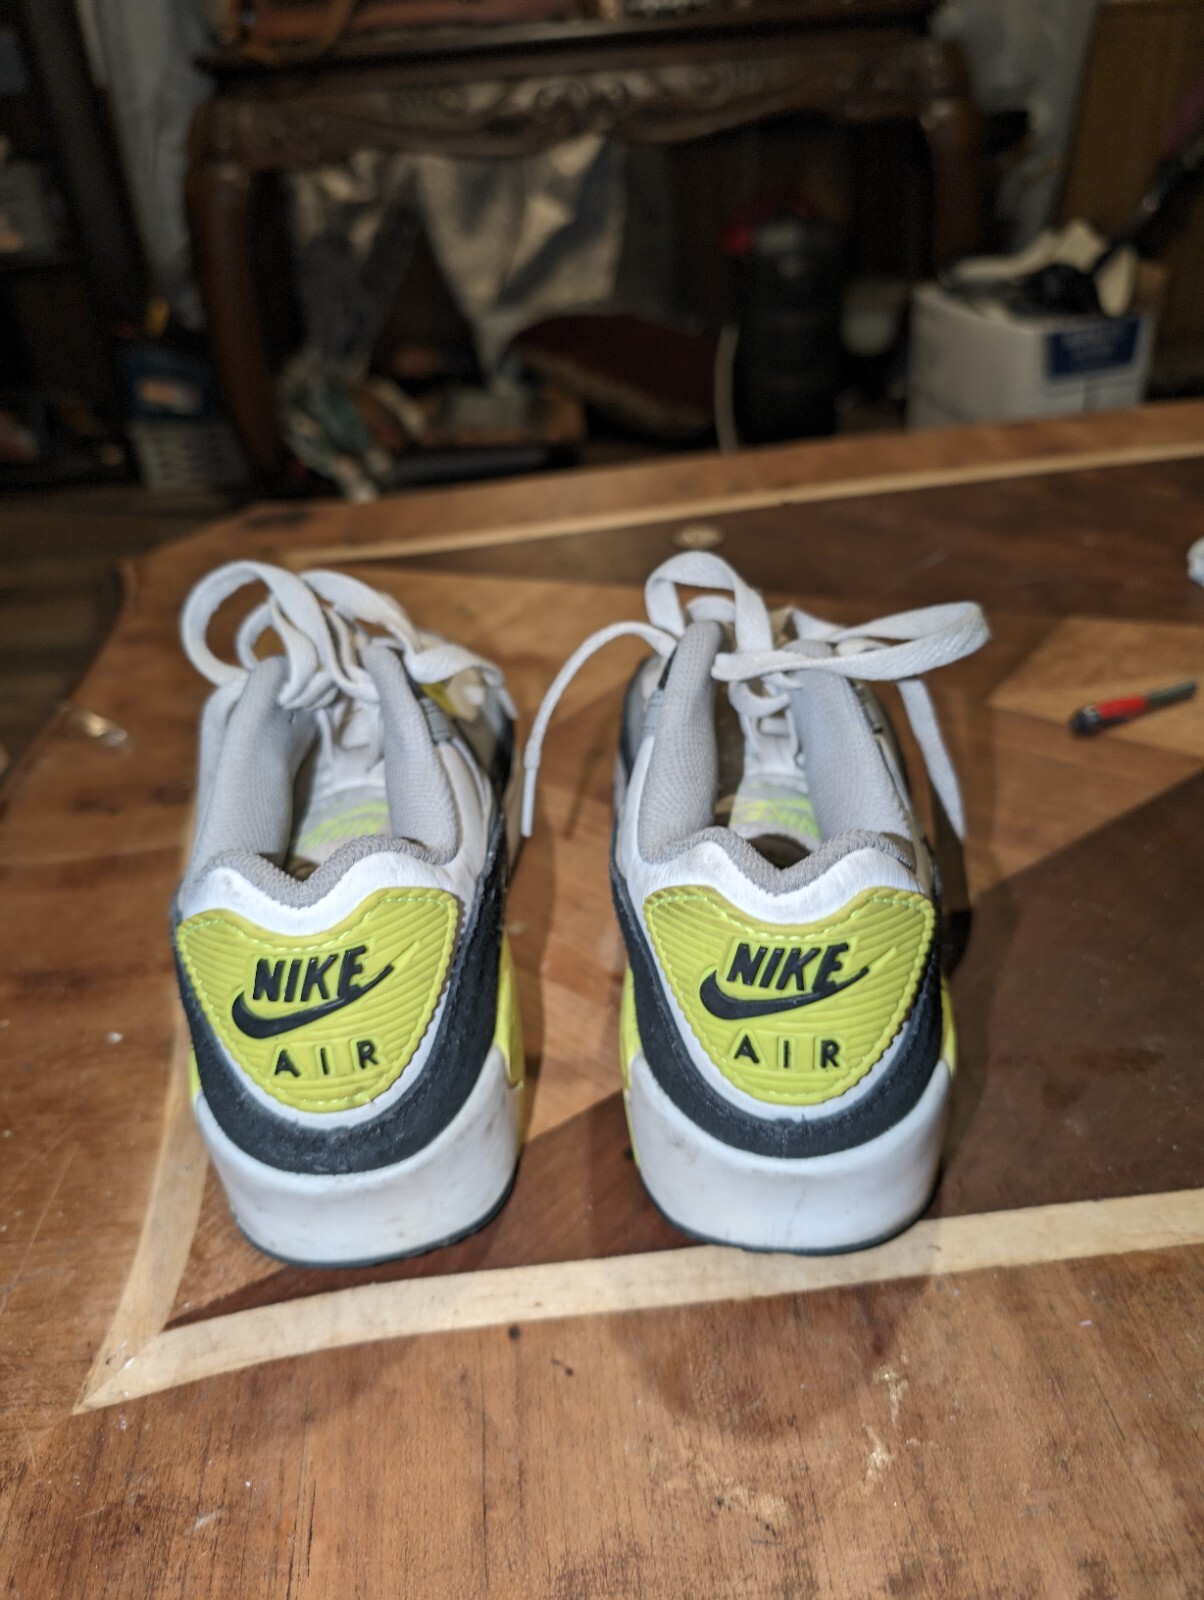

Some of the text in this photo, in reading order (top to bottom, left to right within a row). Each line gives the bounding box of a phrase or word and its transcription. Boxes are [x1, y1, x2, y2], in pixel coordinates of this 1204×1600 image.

[252, 945, 367, 1002] NIKE
[727, 942, 849, 992] NIKE
[274, 1040, 378, 1077] AIR
[734, 1034, 840, 1069] AIR
